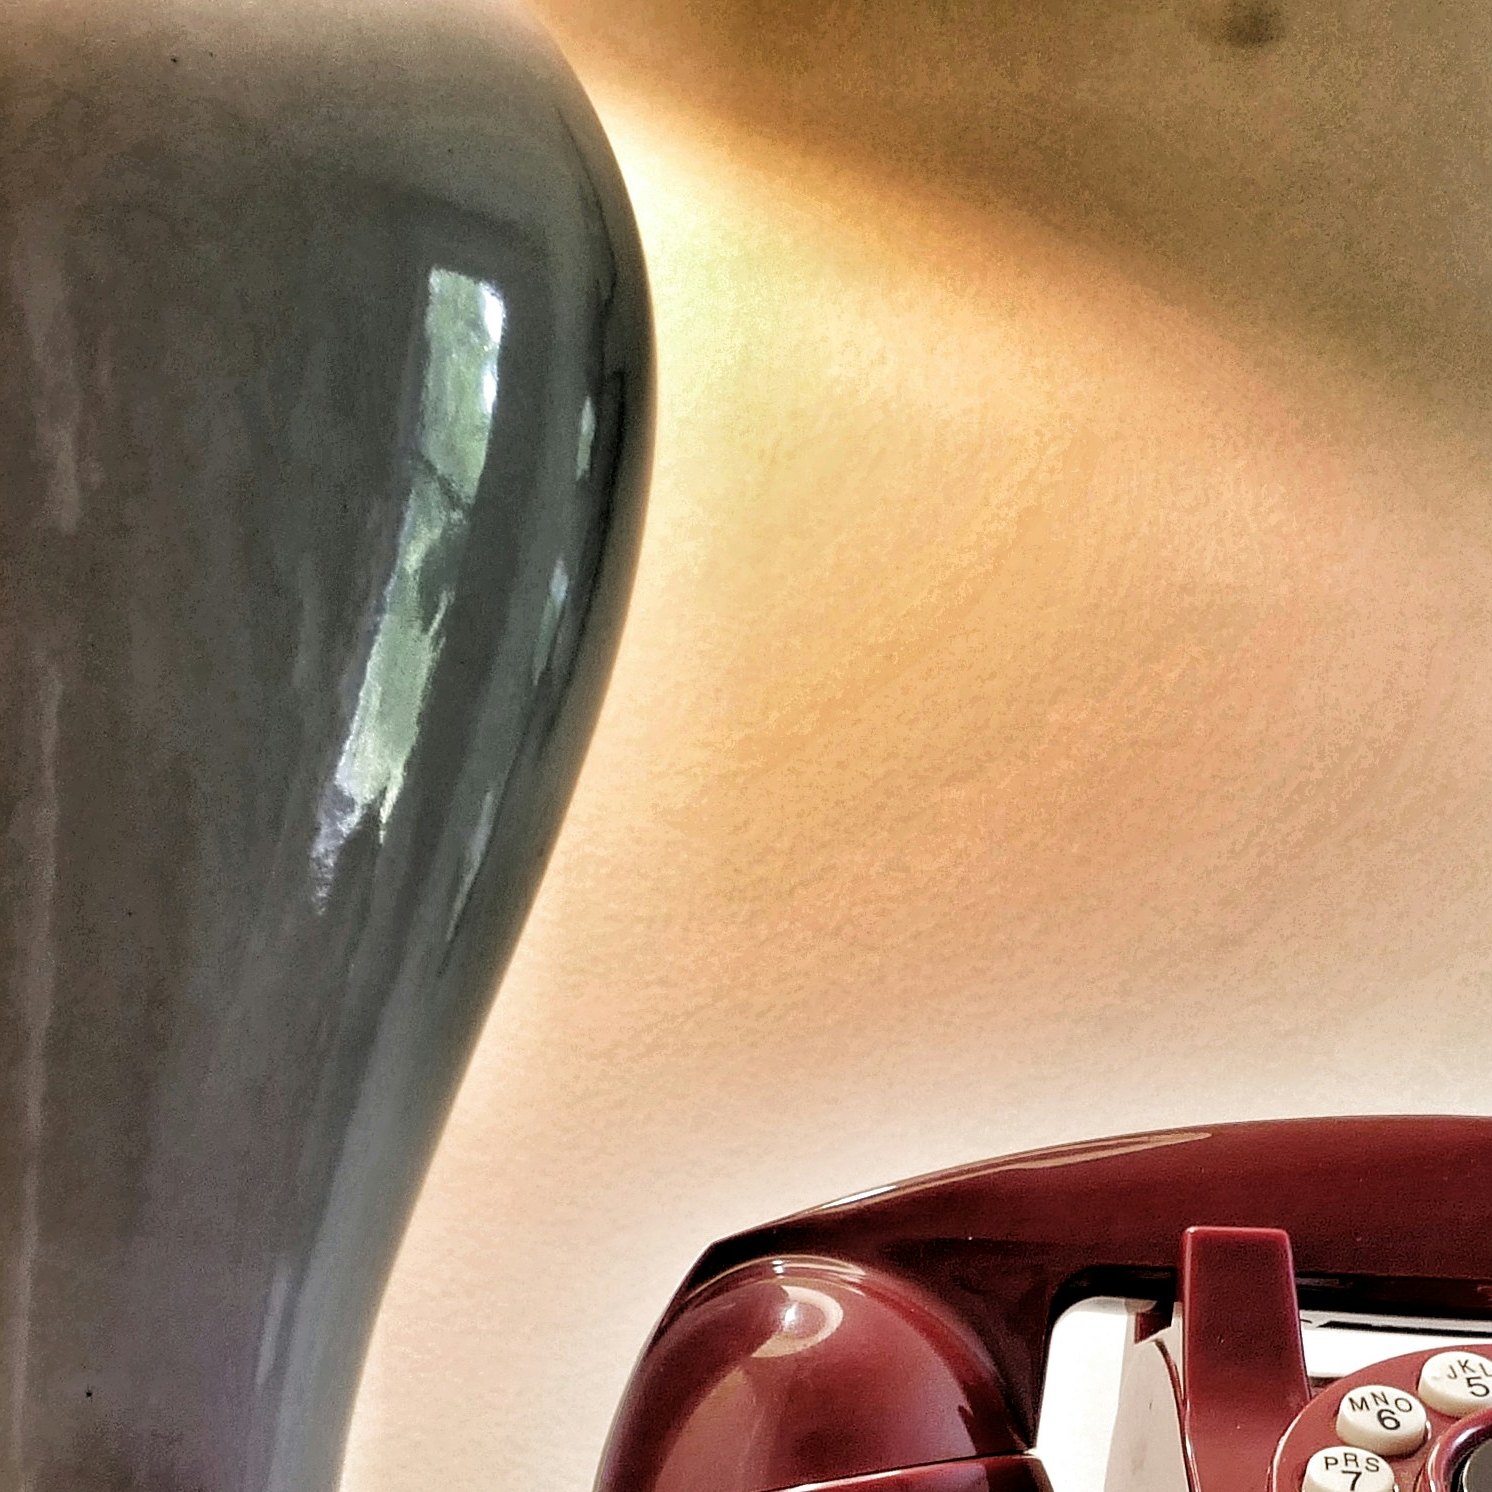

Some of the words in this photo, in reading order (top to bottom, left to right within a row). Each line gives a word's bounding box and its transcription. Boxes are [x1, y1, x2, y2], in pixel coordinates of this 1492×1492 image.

[1466, 1376, 1490, 1397] 5
[1348, 1391, 1413, 1413] MNO
[1377, 1409, 1401, 1431] 6
[1323, 1452, 1380, 1473] PRS
[1341, 1470, 1363, 1491] 7
